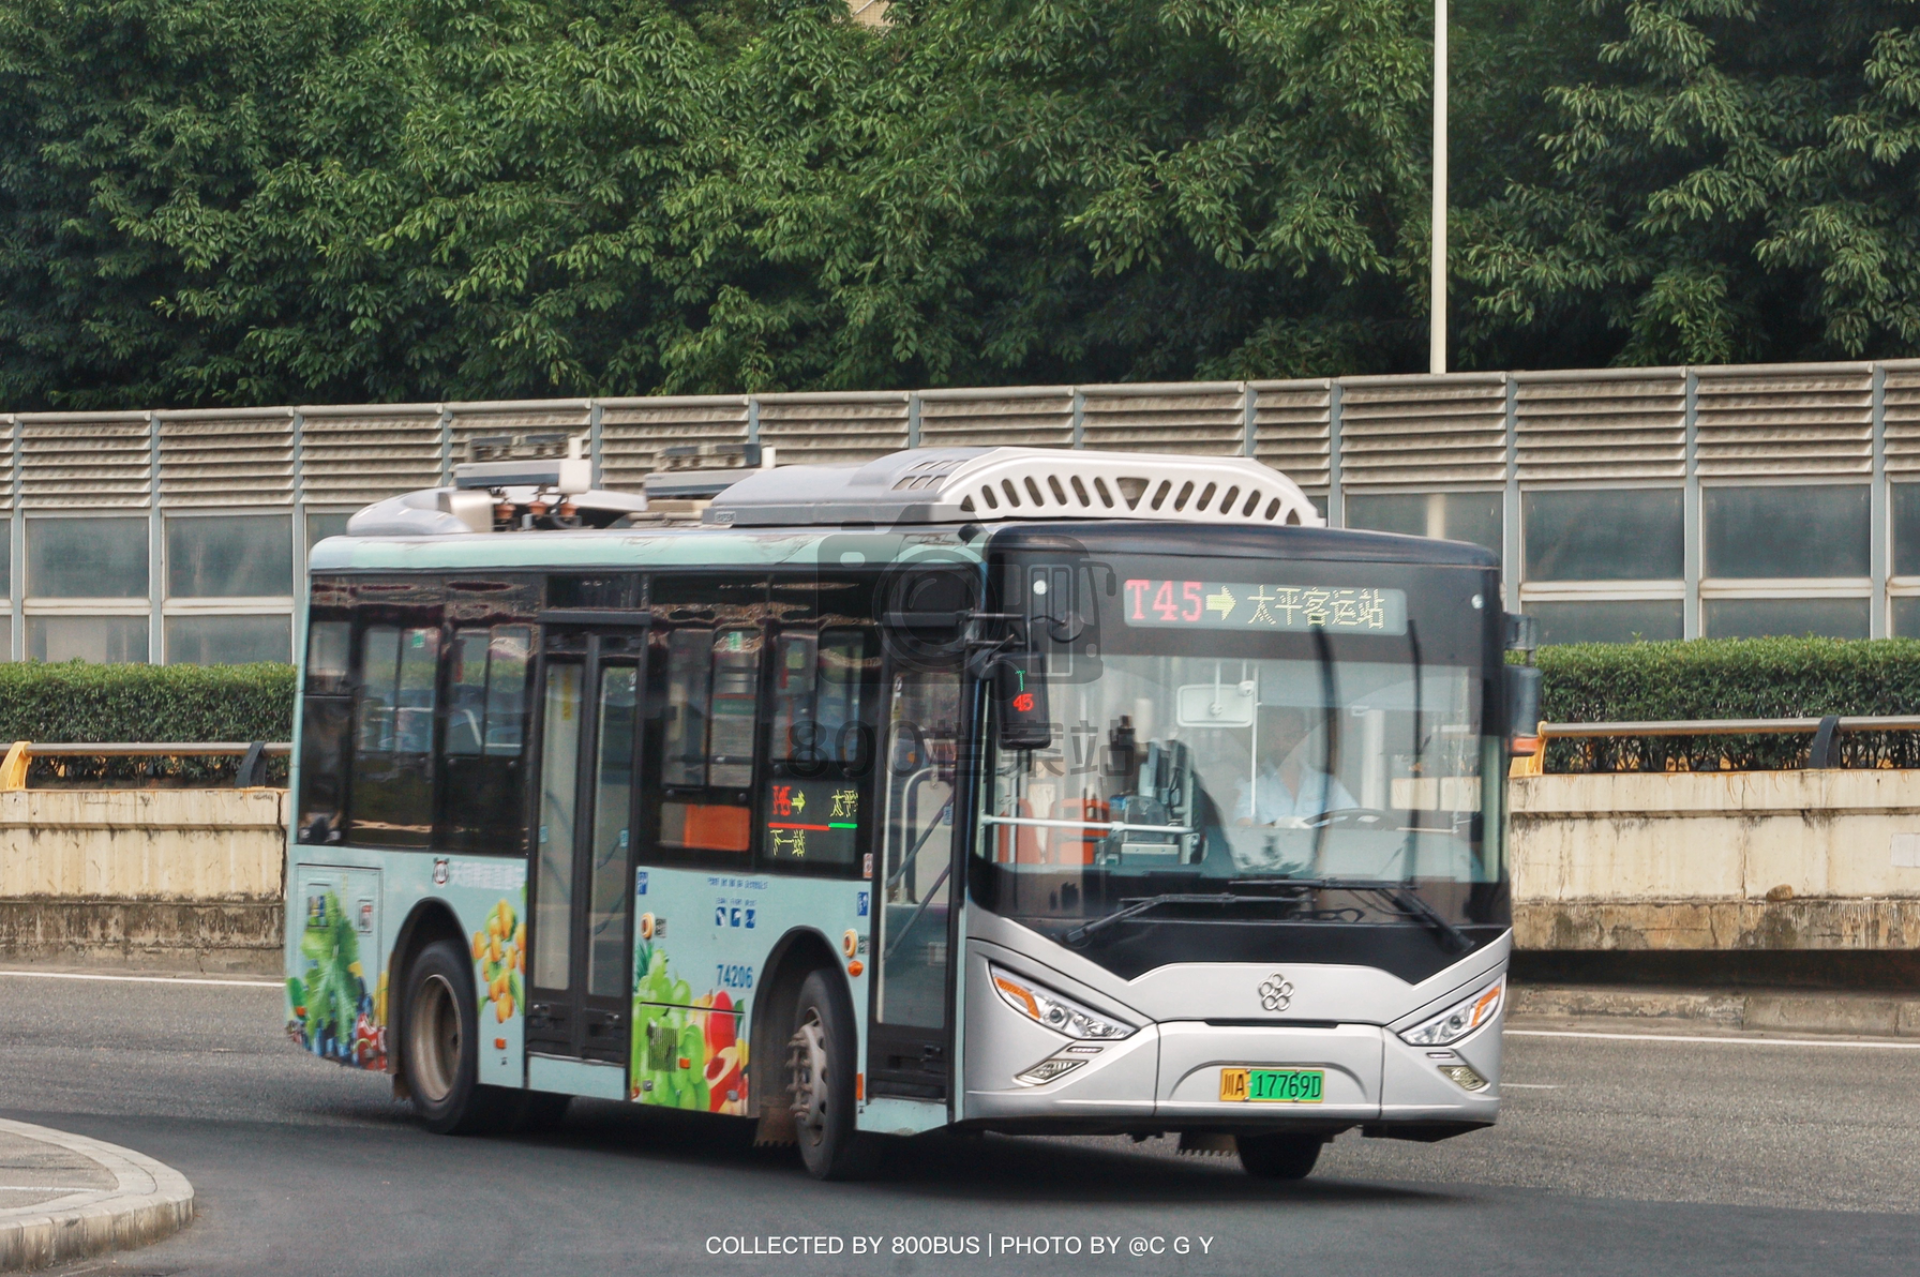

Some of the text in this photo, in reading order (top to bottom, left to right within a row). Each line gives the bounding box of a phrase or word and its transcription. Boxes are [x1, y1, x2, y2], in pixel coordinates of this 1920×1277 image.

[1126, 579, 1386, 630] T45 太平客运站
[716, 963, 754, 990] 74206
[1256, 1073, 1322, 1098] 17769D
